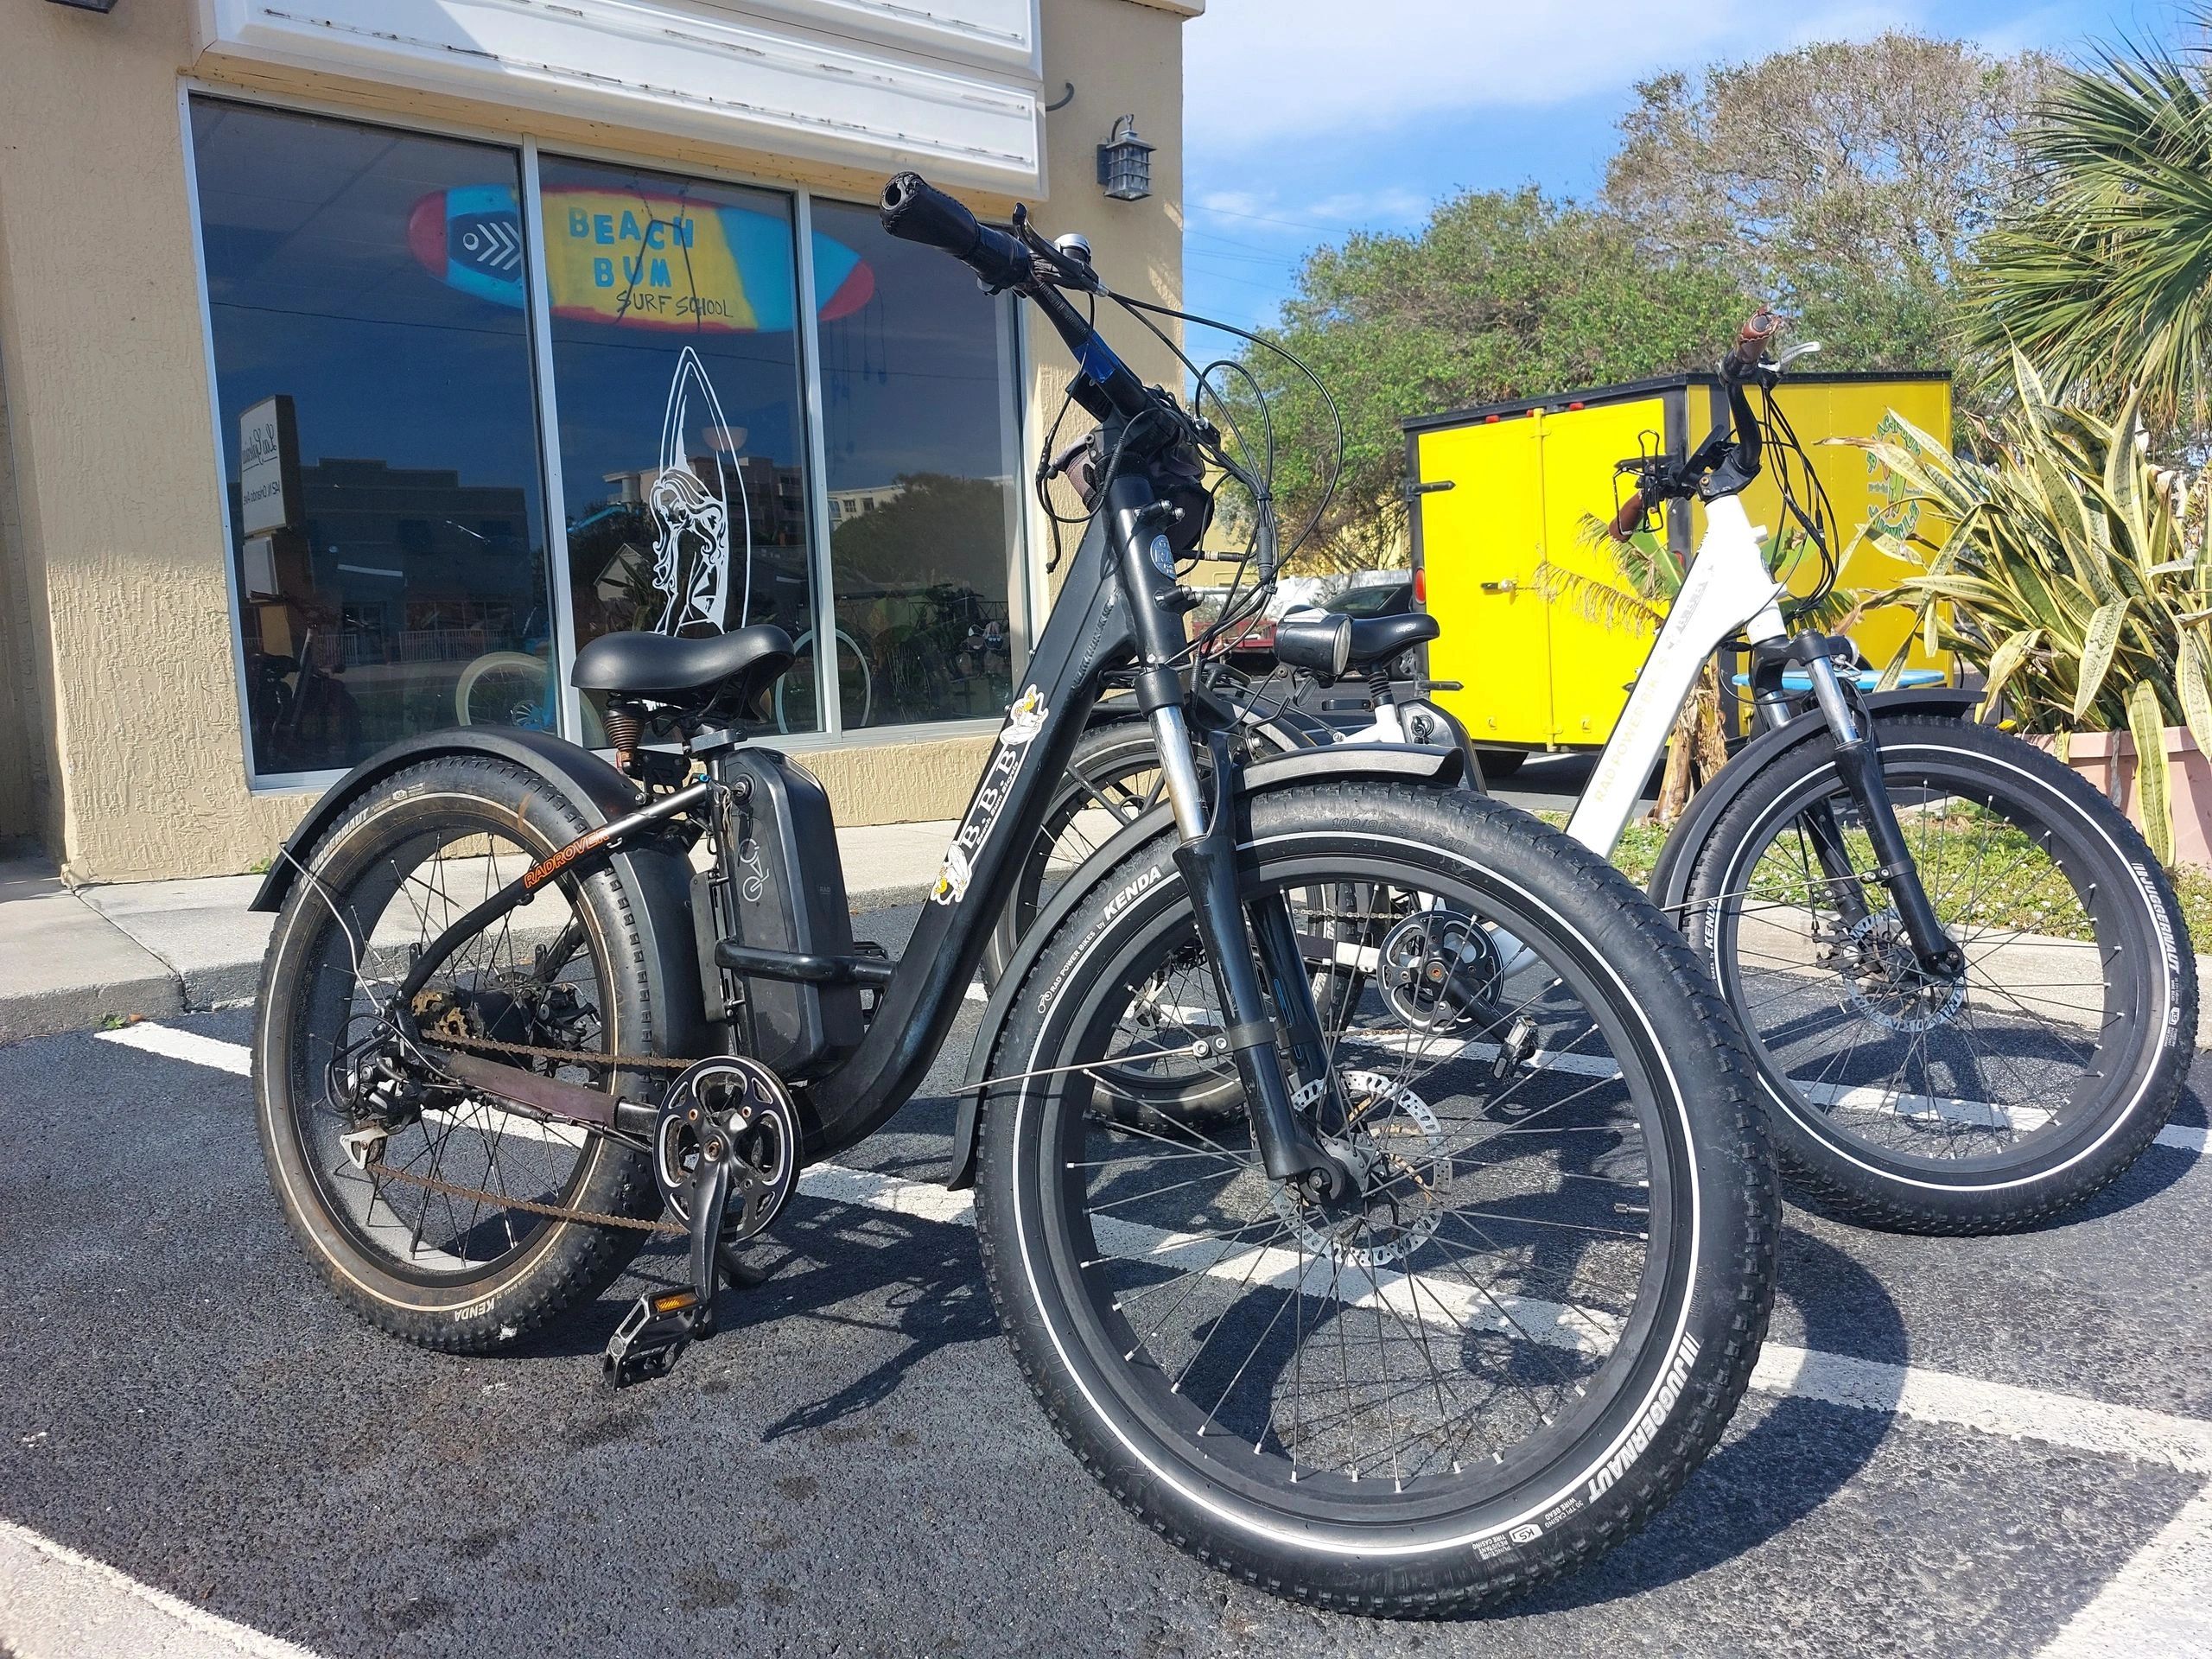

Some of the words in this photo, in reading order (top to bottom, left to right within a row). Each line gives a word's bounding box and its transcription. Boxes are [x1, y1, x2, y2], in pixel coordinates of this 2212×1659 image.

[569, 207, 694, 250] BEACH
[594, 256, 671, 288] BUM
[616, 290, 672, 314] SURF
[676, 296, 734, 318] SCHOOL
[1613, 706, 1648, 765] POWER
[976, 817, 992, 846] Beach
[990, 793, 1003, 817] Bum
[524, 828, 610, 889] RADROVER
[1051, 976, 1062, 993] RAD
[1060, 951, 1080, 976] POWER
[1078, 931, 1096, 951] BIKES
[1096, 921, 1106, 930] by
[1103, 866, 1162, 920] KENDA
[1705, 899, 1718, 950] KENDA
[2140, 874, 2180, 974] JUGGERNAUT
[454, 1297, 495, 1322] KENDA
[1588, 1357, 1687, 1503] JUGGERNAUT
[1560, 1497, 1578, 1509] WIRE
[1566, 1503, 1578, 1515] TPI
[1491, 1534, 1507, 1544] TIRE
